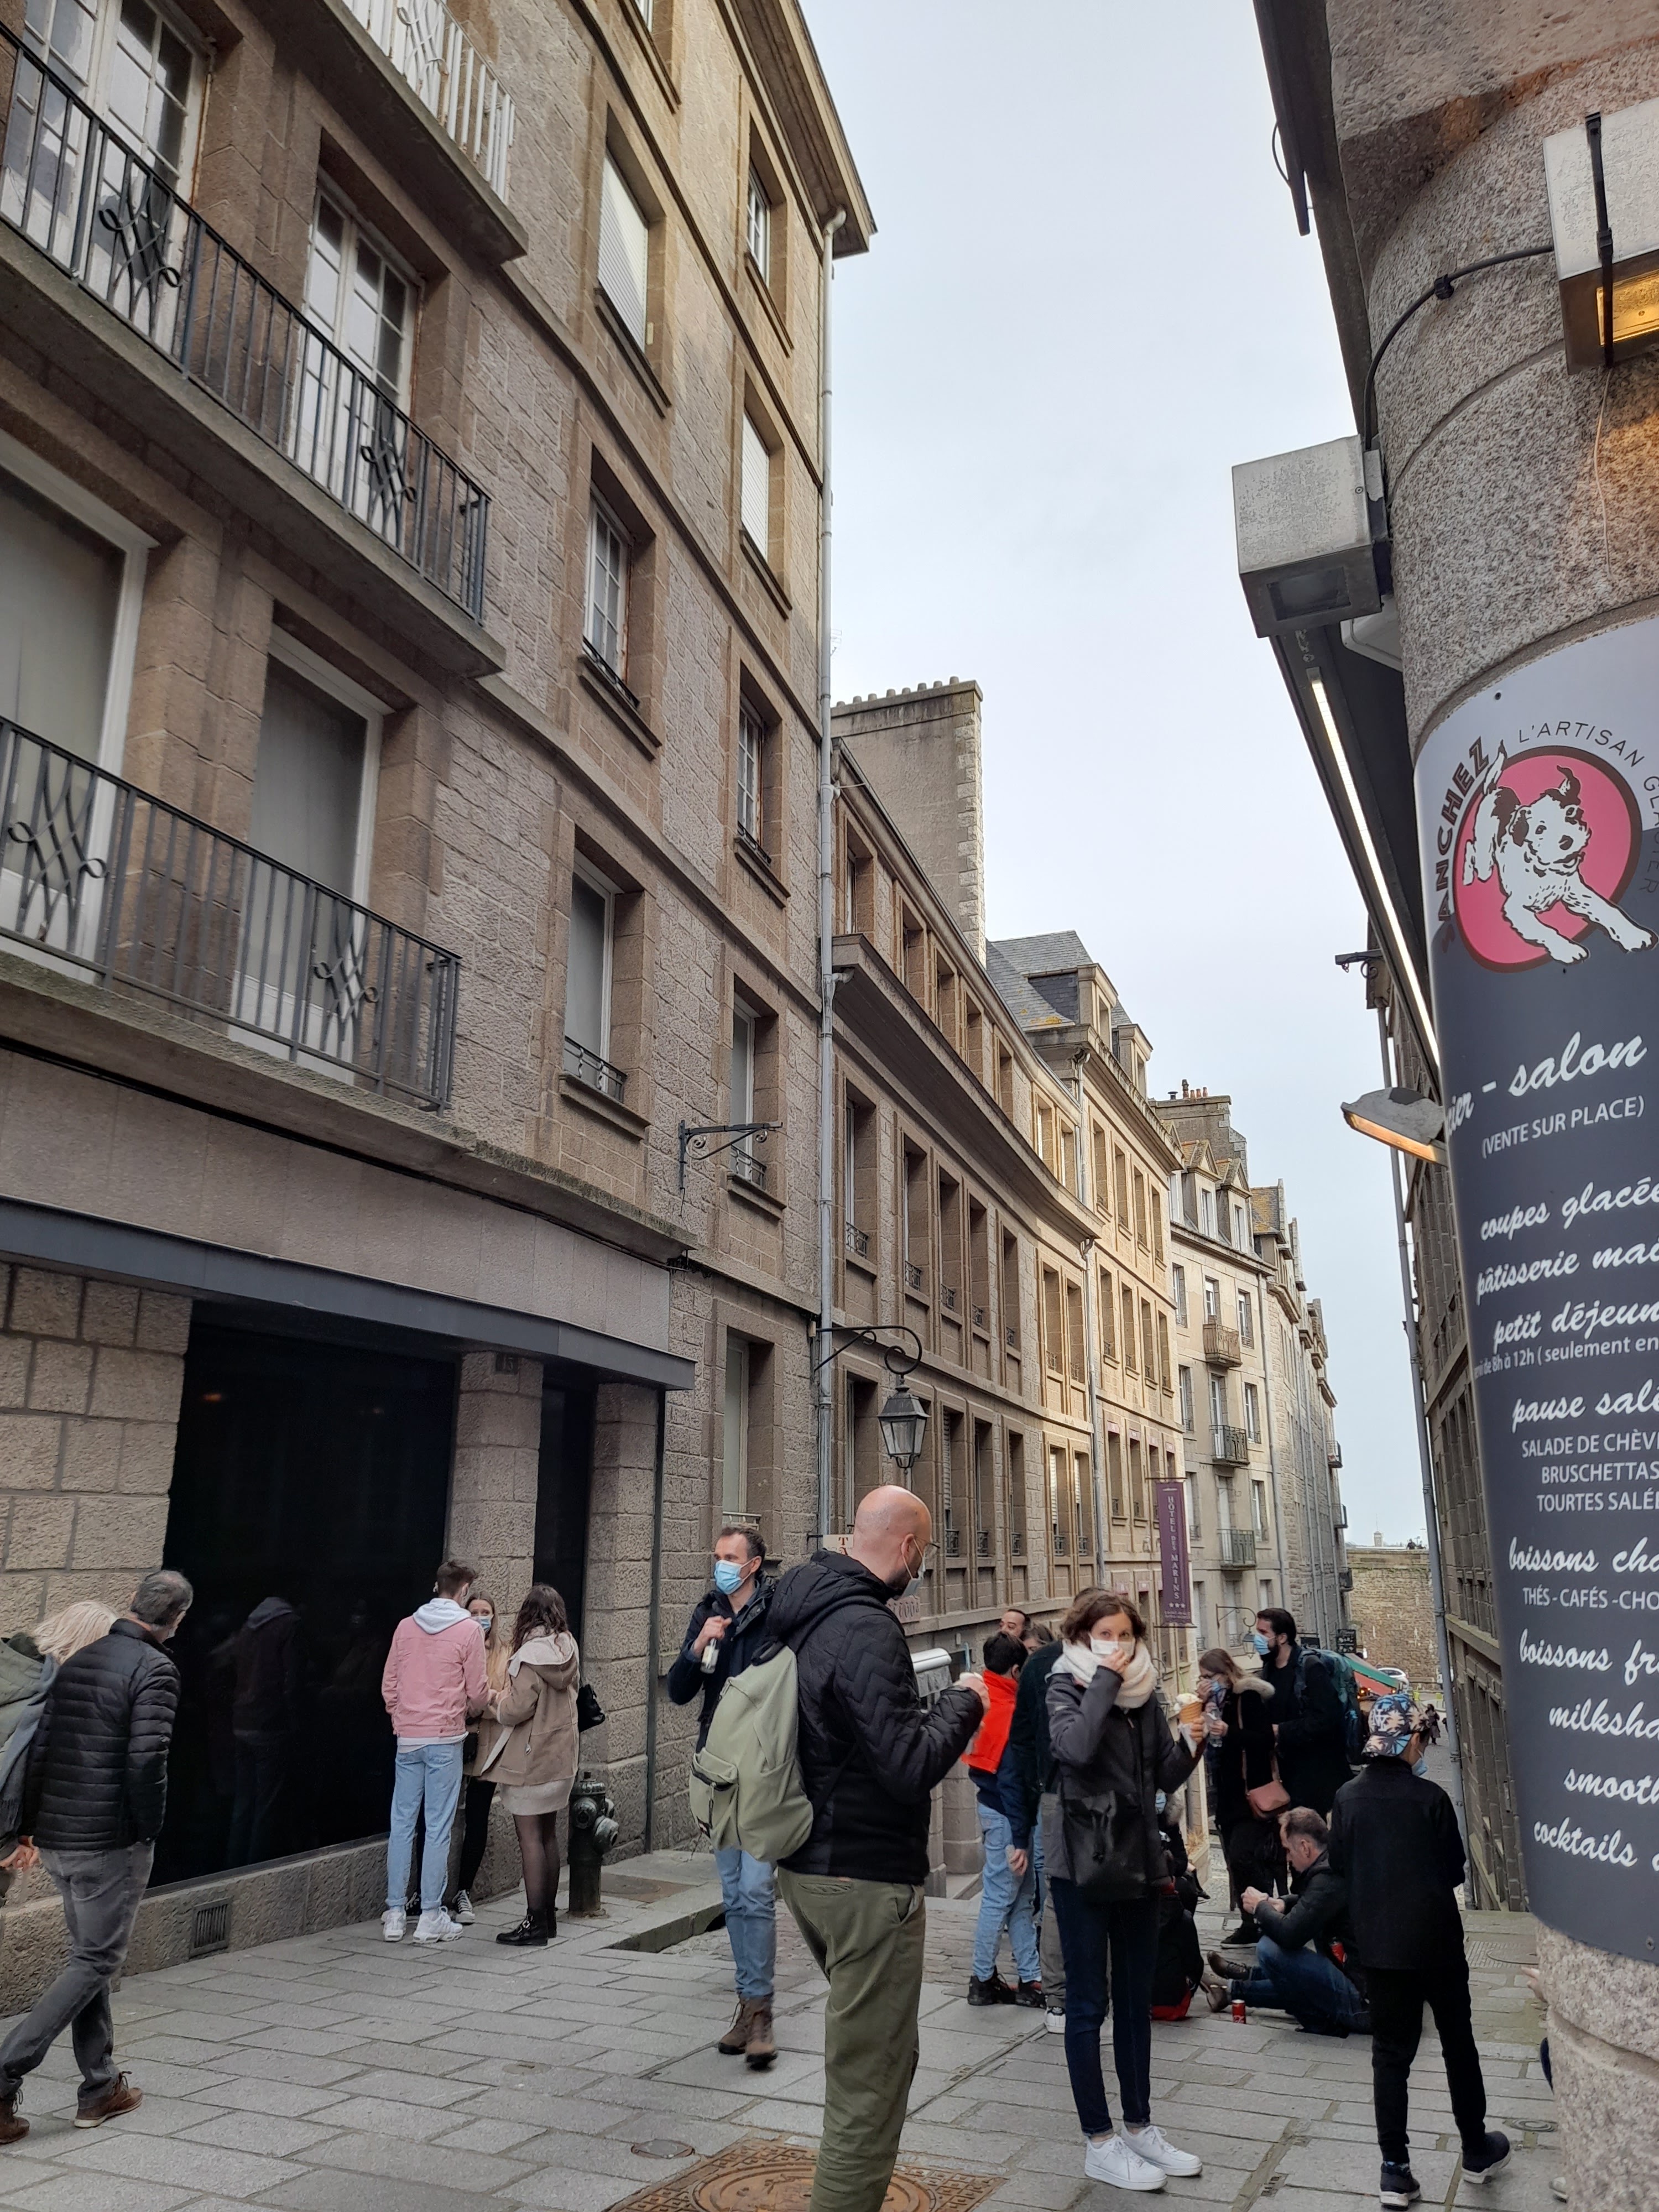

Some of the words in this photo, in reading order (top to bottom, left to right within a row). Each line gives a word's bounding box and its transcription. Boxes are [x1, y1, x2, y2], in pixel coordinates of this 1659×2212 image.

[1519, 721, 1645, 769] L'ARTISAN
[1509, 1031, 1647, 1097] salon
[1482, 1123, 1528, 1158] (VENTE
[1531, 1110, 1567, 1139] SUR
[1570, 1095, 1646, 1129] PLACE)
[1480, 1201, 1551, 1240] coupes
[1476, 1251, 1580, 1306] pâtisserie
[1493, 1310, 1542, 1354] petit
[1491, 1354, 1503, 1372] 8h
[1504, 1352, 1511, 1369] à
[1513, 1347, 1535, 1368] 12h
[1544, 1335, 1631, 1362] seulement
[1511, 1396, 1586, 1433] pause
[1521, 1436, 1573, 1458] SALADE
[1577, 1434, 1599, 1453] DE
[1603, 1428, 1659, 1452] CHÈV
[1541, 1460, 1659, 1484] BRUSCHETTAS
[1536, 1493, 1604, 1512] TOURTES
[1509, 1536, 1600, 1572] boissons
[1171, 1554, 1181, 1600] MARINS
[1522, 1584, 1550, 1606] THÉS
[1559, 1586, 1608, 1609] CAFÉS
[1519, 1627, 1613, 1671] boissons
[1533, 1817, 1638, 1867] cocktails
